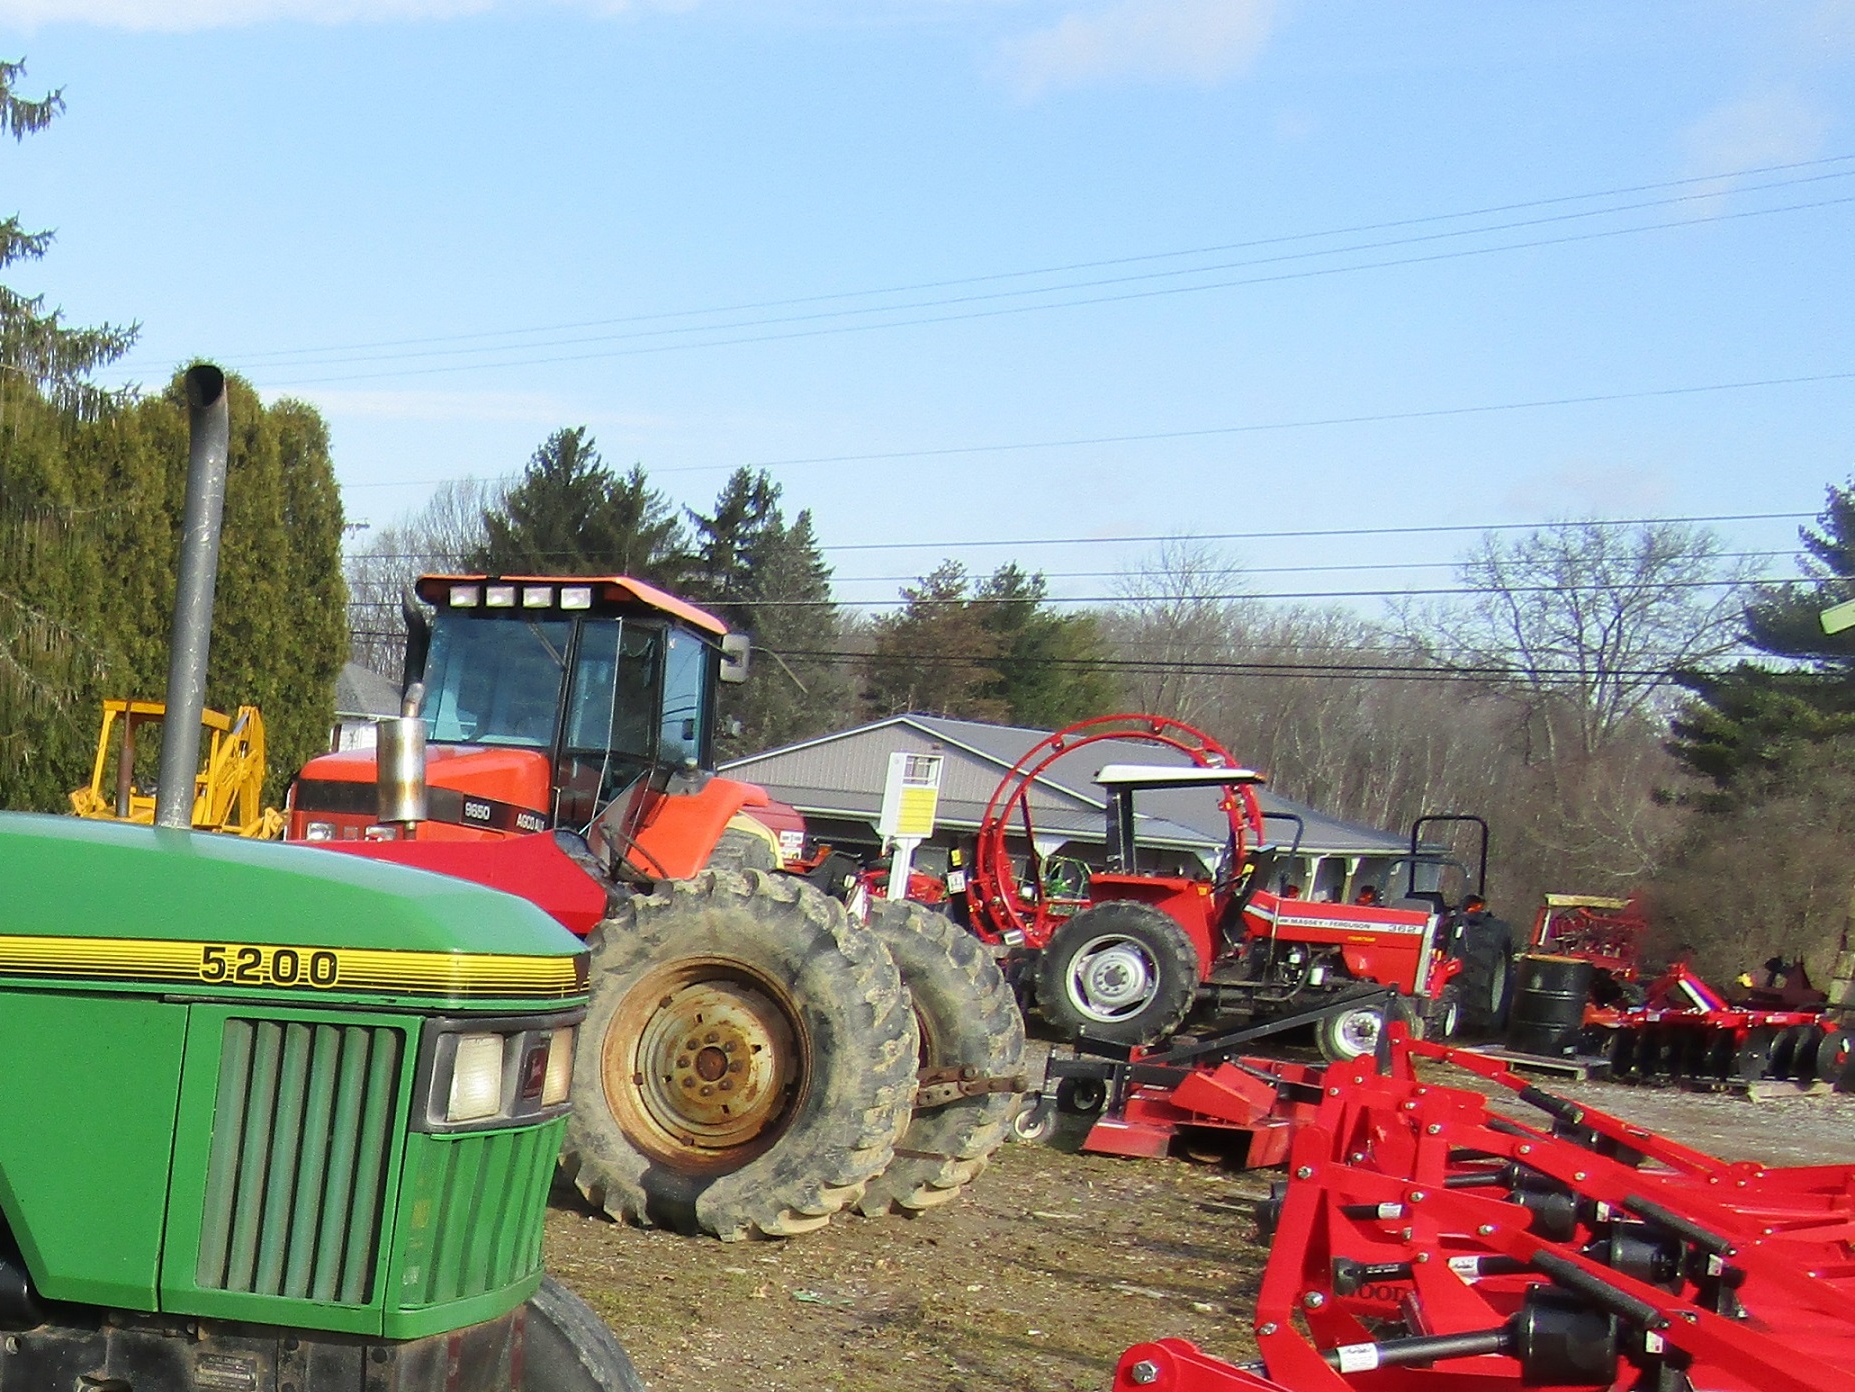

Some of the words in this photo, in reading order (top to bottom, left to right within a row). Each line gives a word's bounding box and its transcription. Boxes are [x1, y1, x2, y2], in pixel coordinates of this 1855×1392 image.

[465, 802, 491, 820] 9650
[516, 813, 535, 830] AGCO
[1388, 924, 1417, 934] 362
[200, 946, 338, 987] 5200
